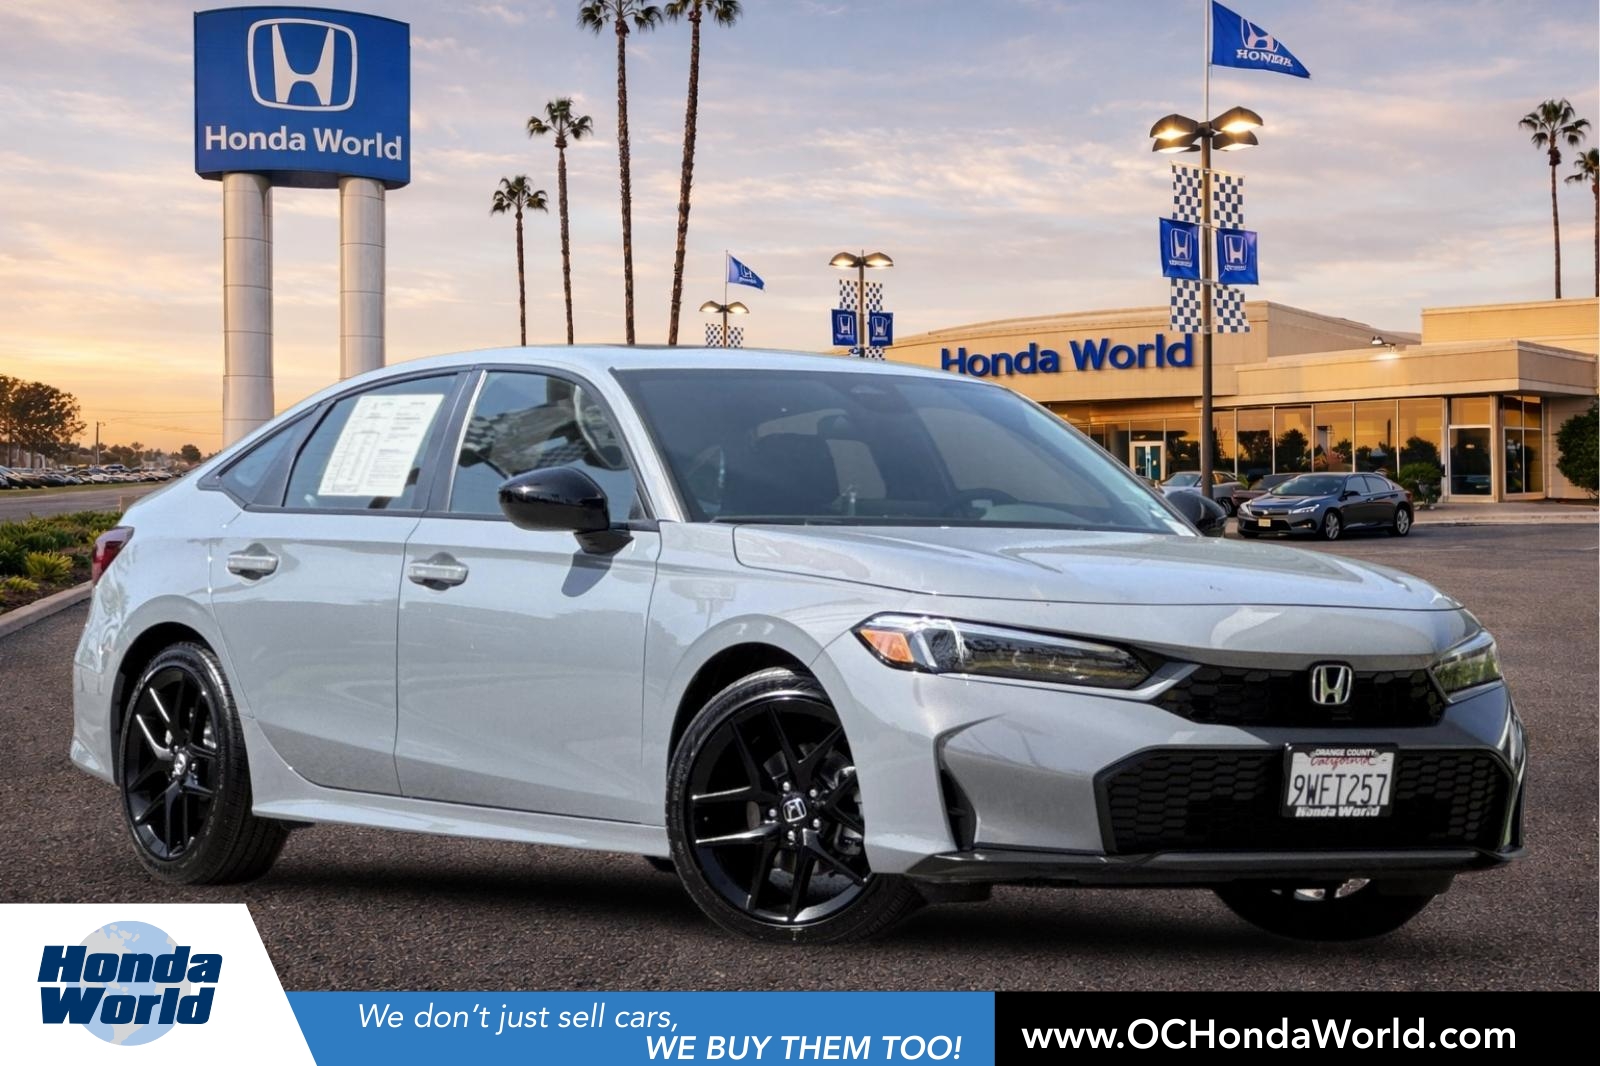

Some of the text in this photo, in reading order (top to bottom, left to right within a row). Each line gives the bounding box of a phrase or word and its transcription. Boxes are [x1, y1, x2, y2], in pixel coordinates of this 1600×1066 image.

[205, 125, 402, 160] Honda World
[941, 333, 1194, 377] Honda World
[1291, 773, 1388, 806] 9WFT257
[1295, 806, 1380, 817] Honda World
